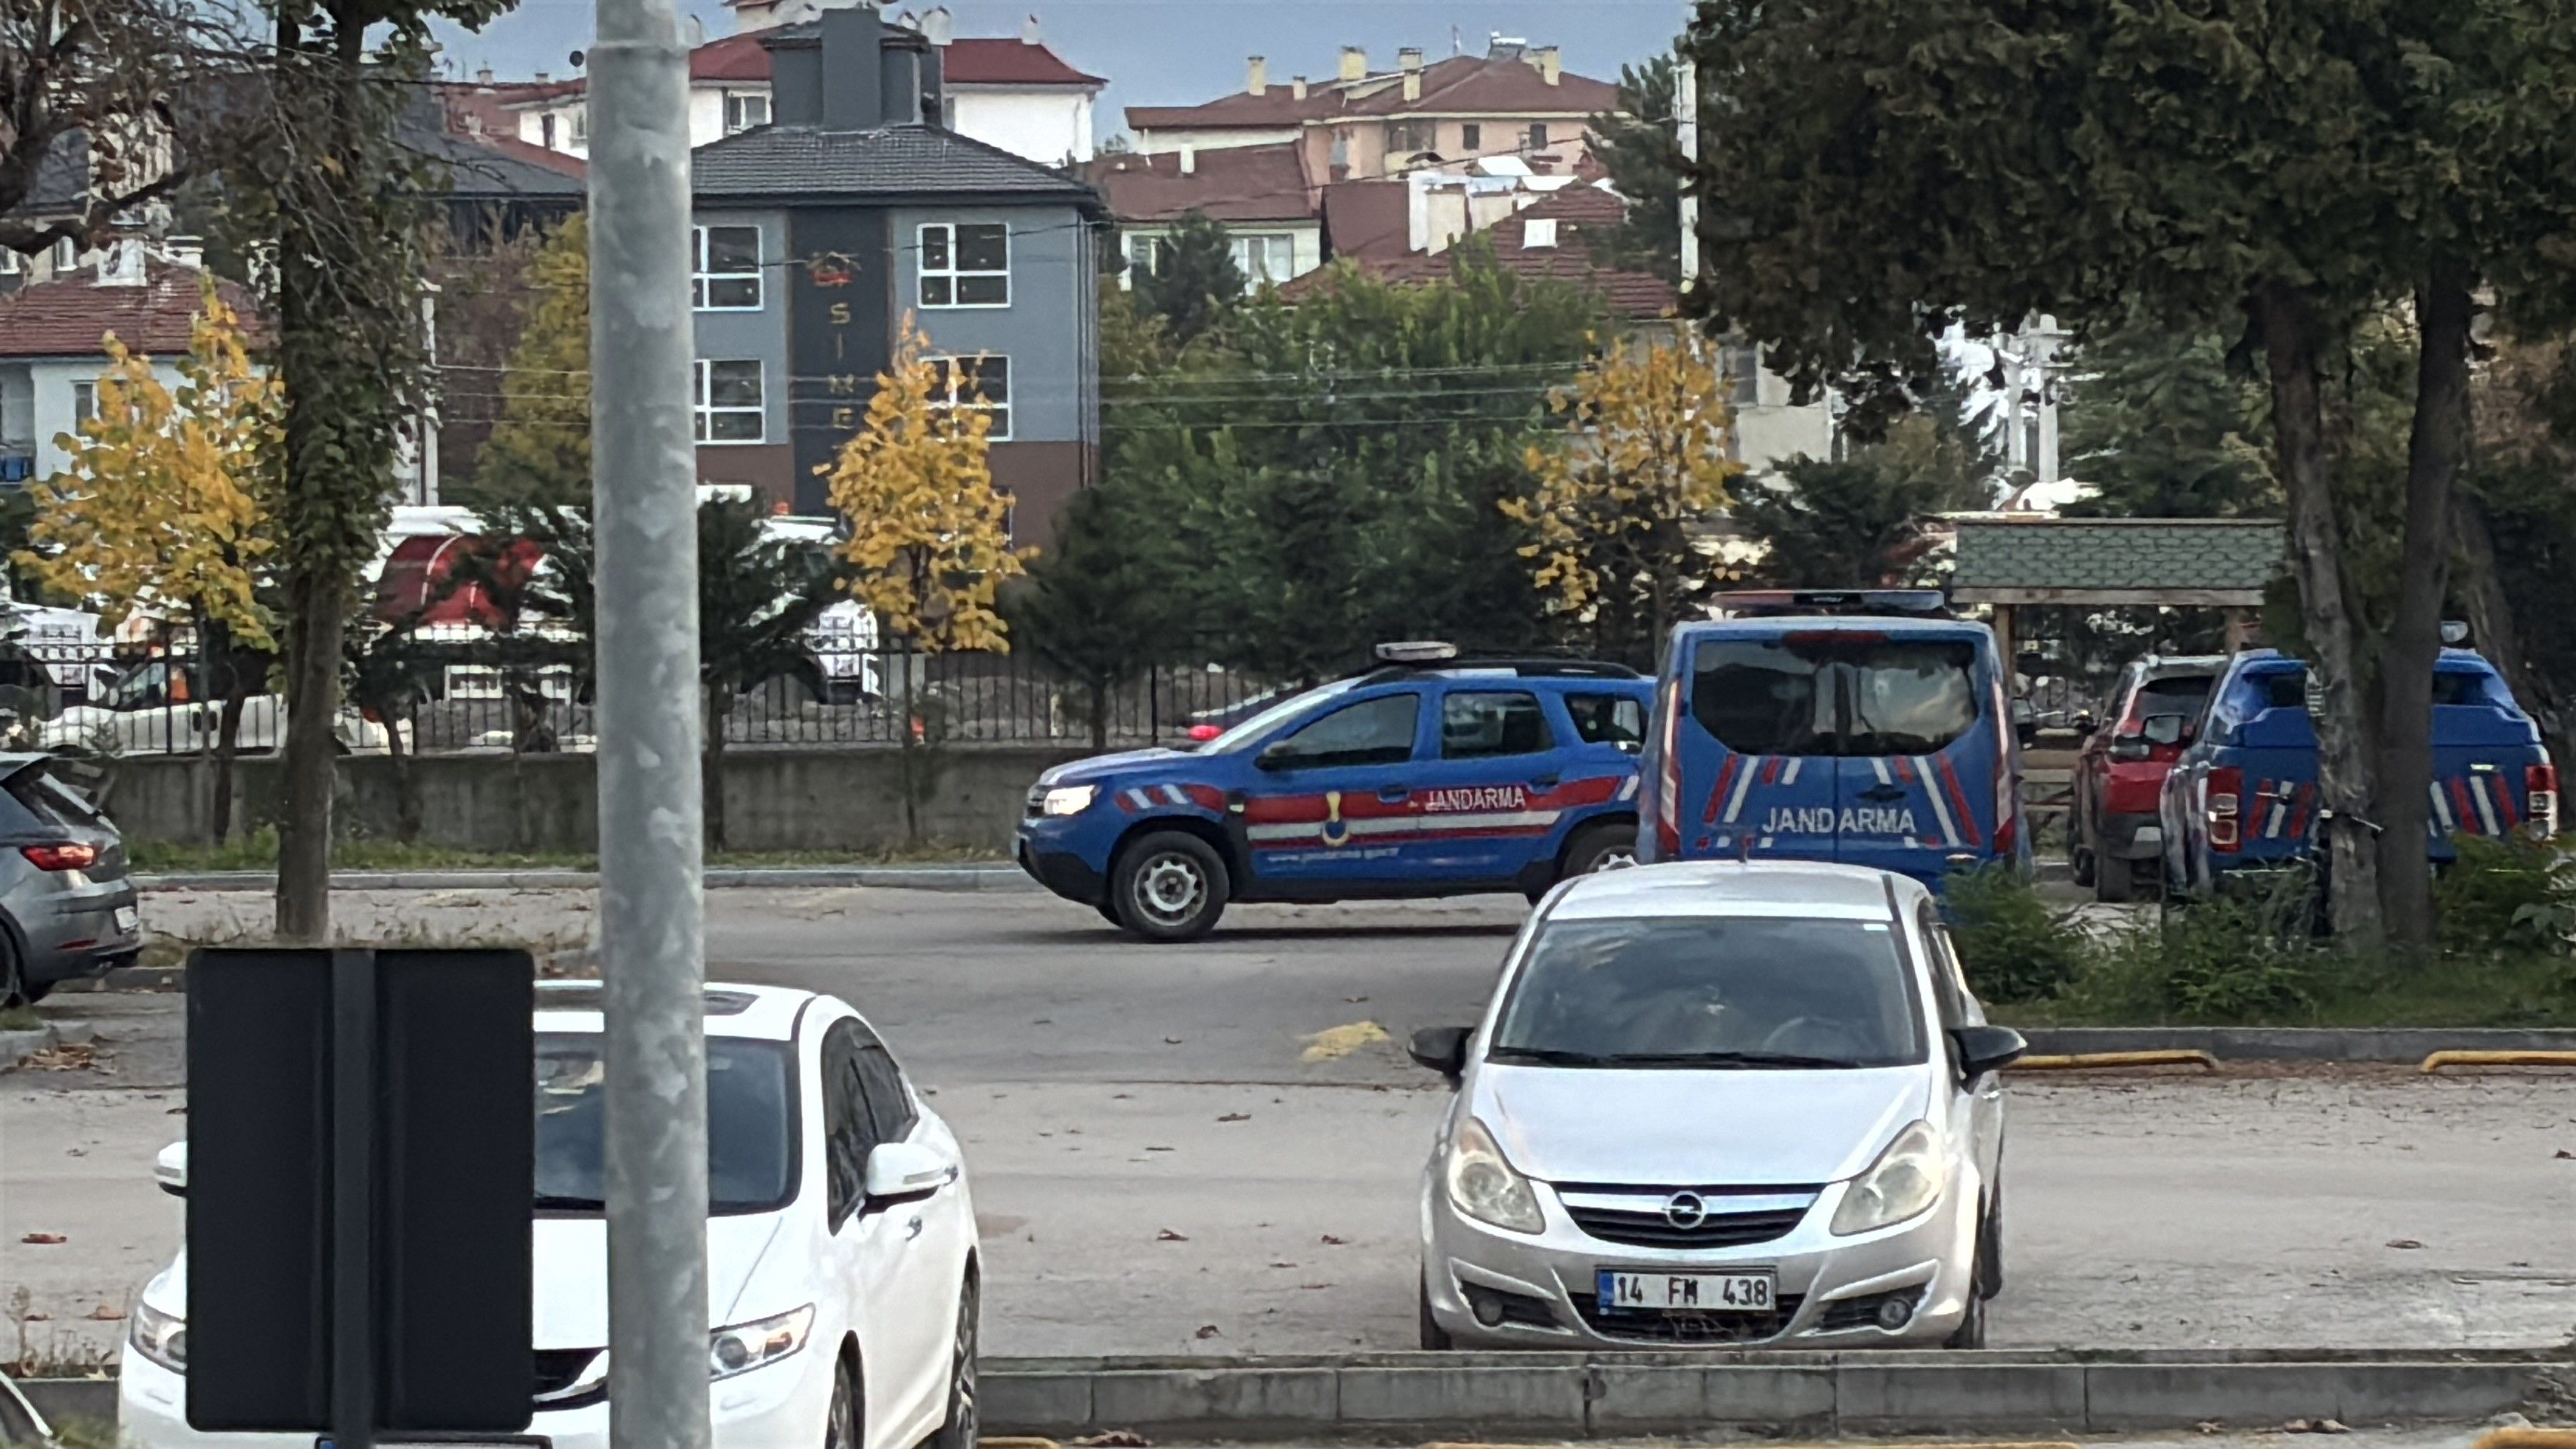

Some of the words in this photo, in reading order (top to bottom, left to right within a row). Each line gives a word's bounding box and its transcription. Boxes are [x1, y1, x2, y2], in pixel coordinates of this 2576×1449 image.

[1425, 786, 1526, 812] JANDARMA
[1761, 806, 1917, 834] JANDARMA
[1618, 1276, 1643, 1303] 14
[1668, 1277, 1699, 1306] FM
[1723, 1278, 1768, 1306] 438
